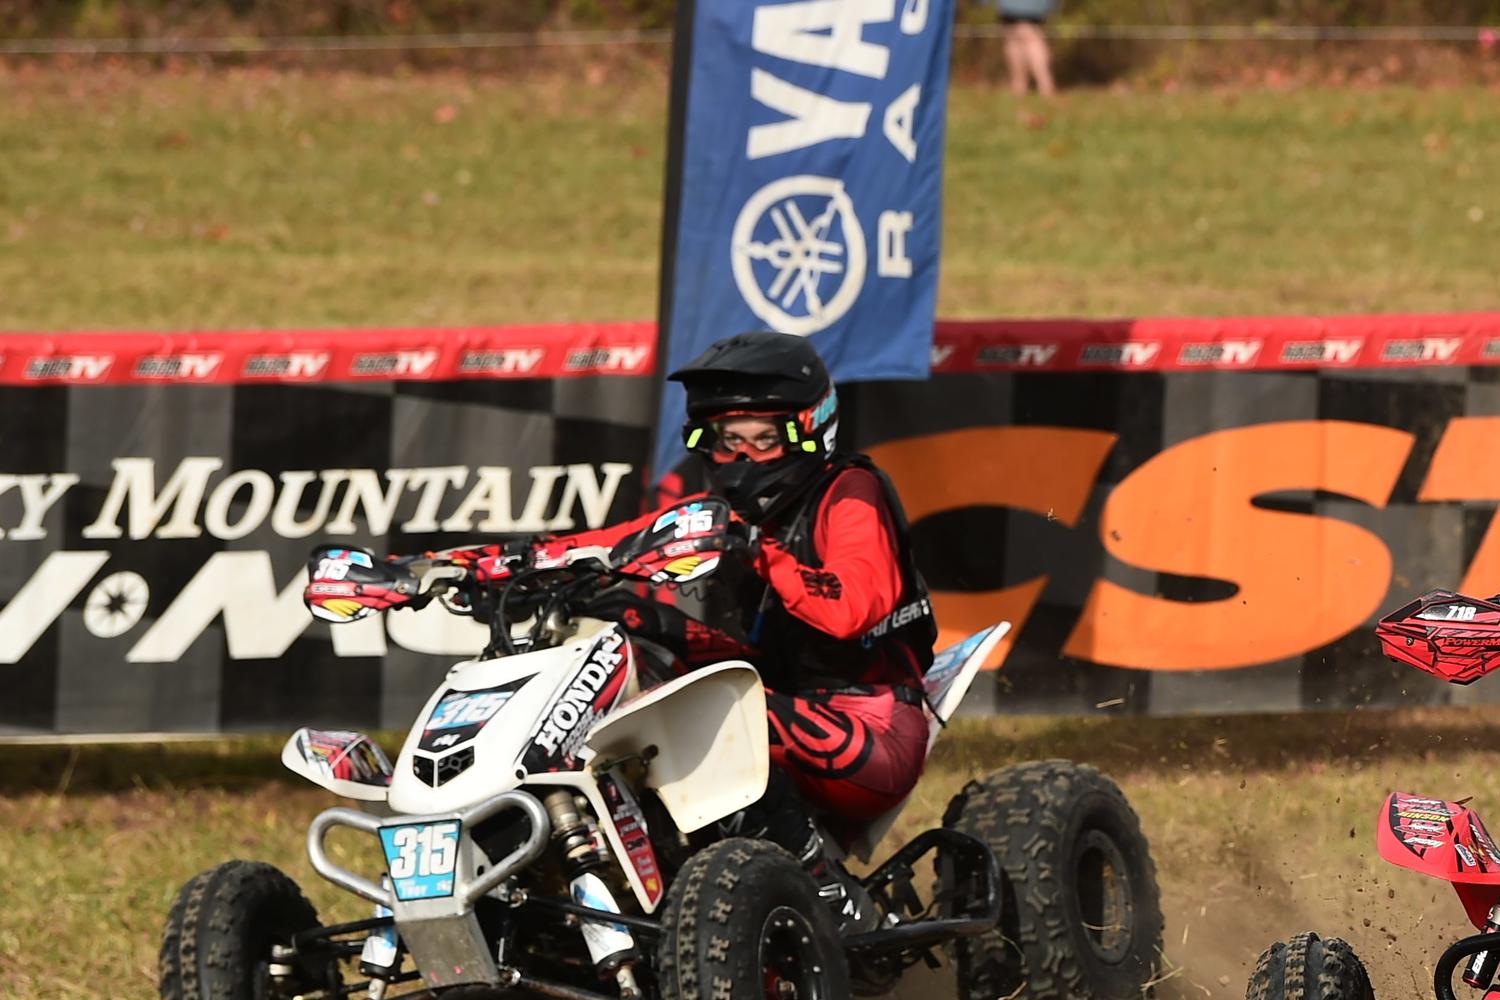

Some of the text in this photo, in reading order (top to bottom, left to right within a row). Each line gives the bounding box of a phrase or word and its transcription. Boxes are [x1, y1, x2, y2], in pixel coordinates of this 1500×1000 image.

[82, 457, 632, 540] MOUNTAIN
[674, 510, 713, 539] 315
[314, 558, 353, 580] 315
[1448, 605, 1477, 621] 718
[534, 650, 624, 758] HONDA
[391, 823, 457, 879] 315
